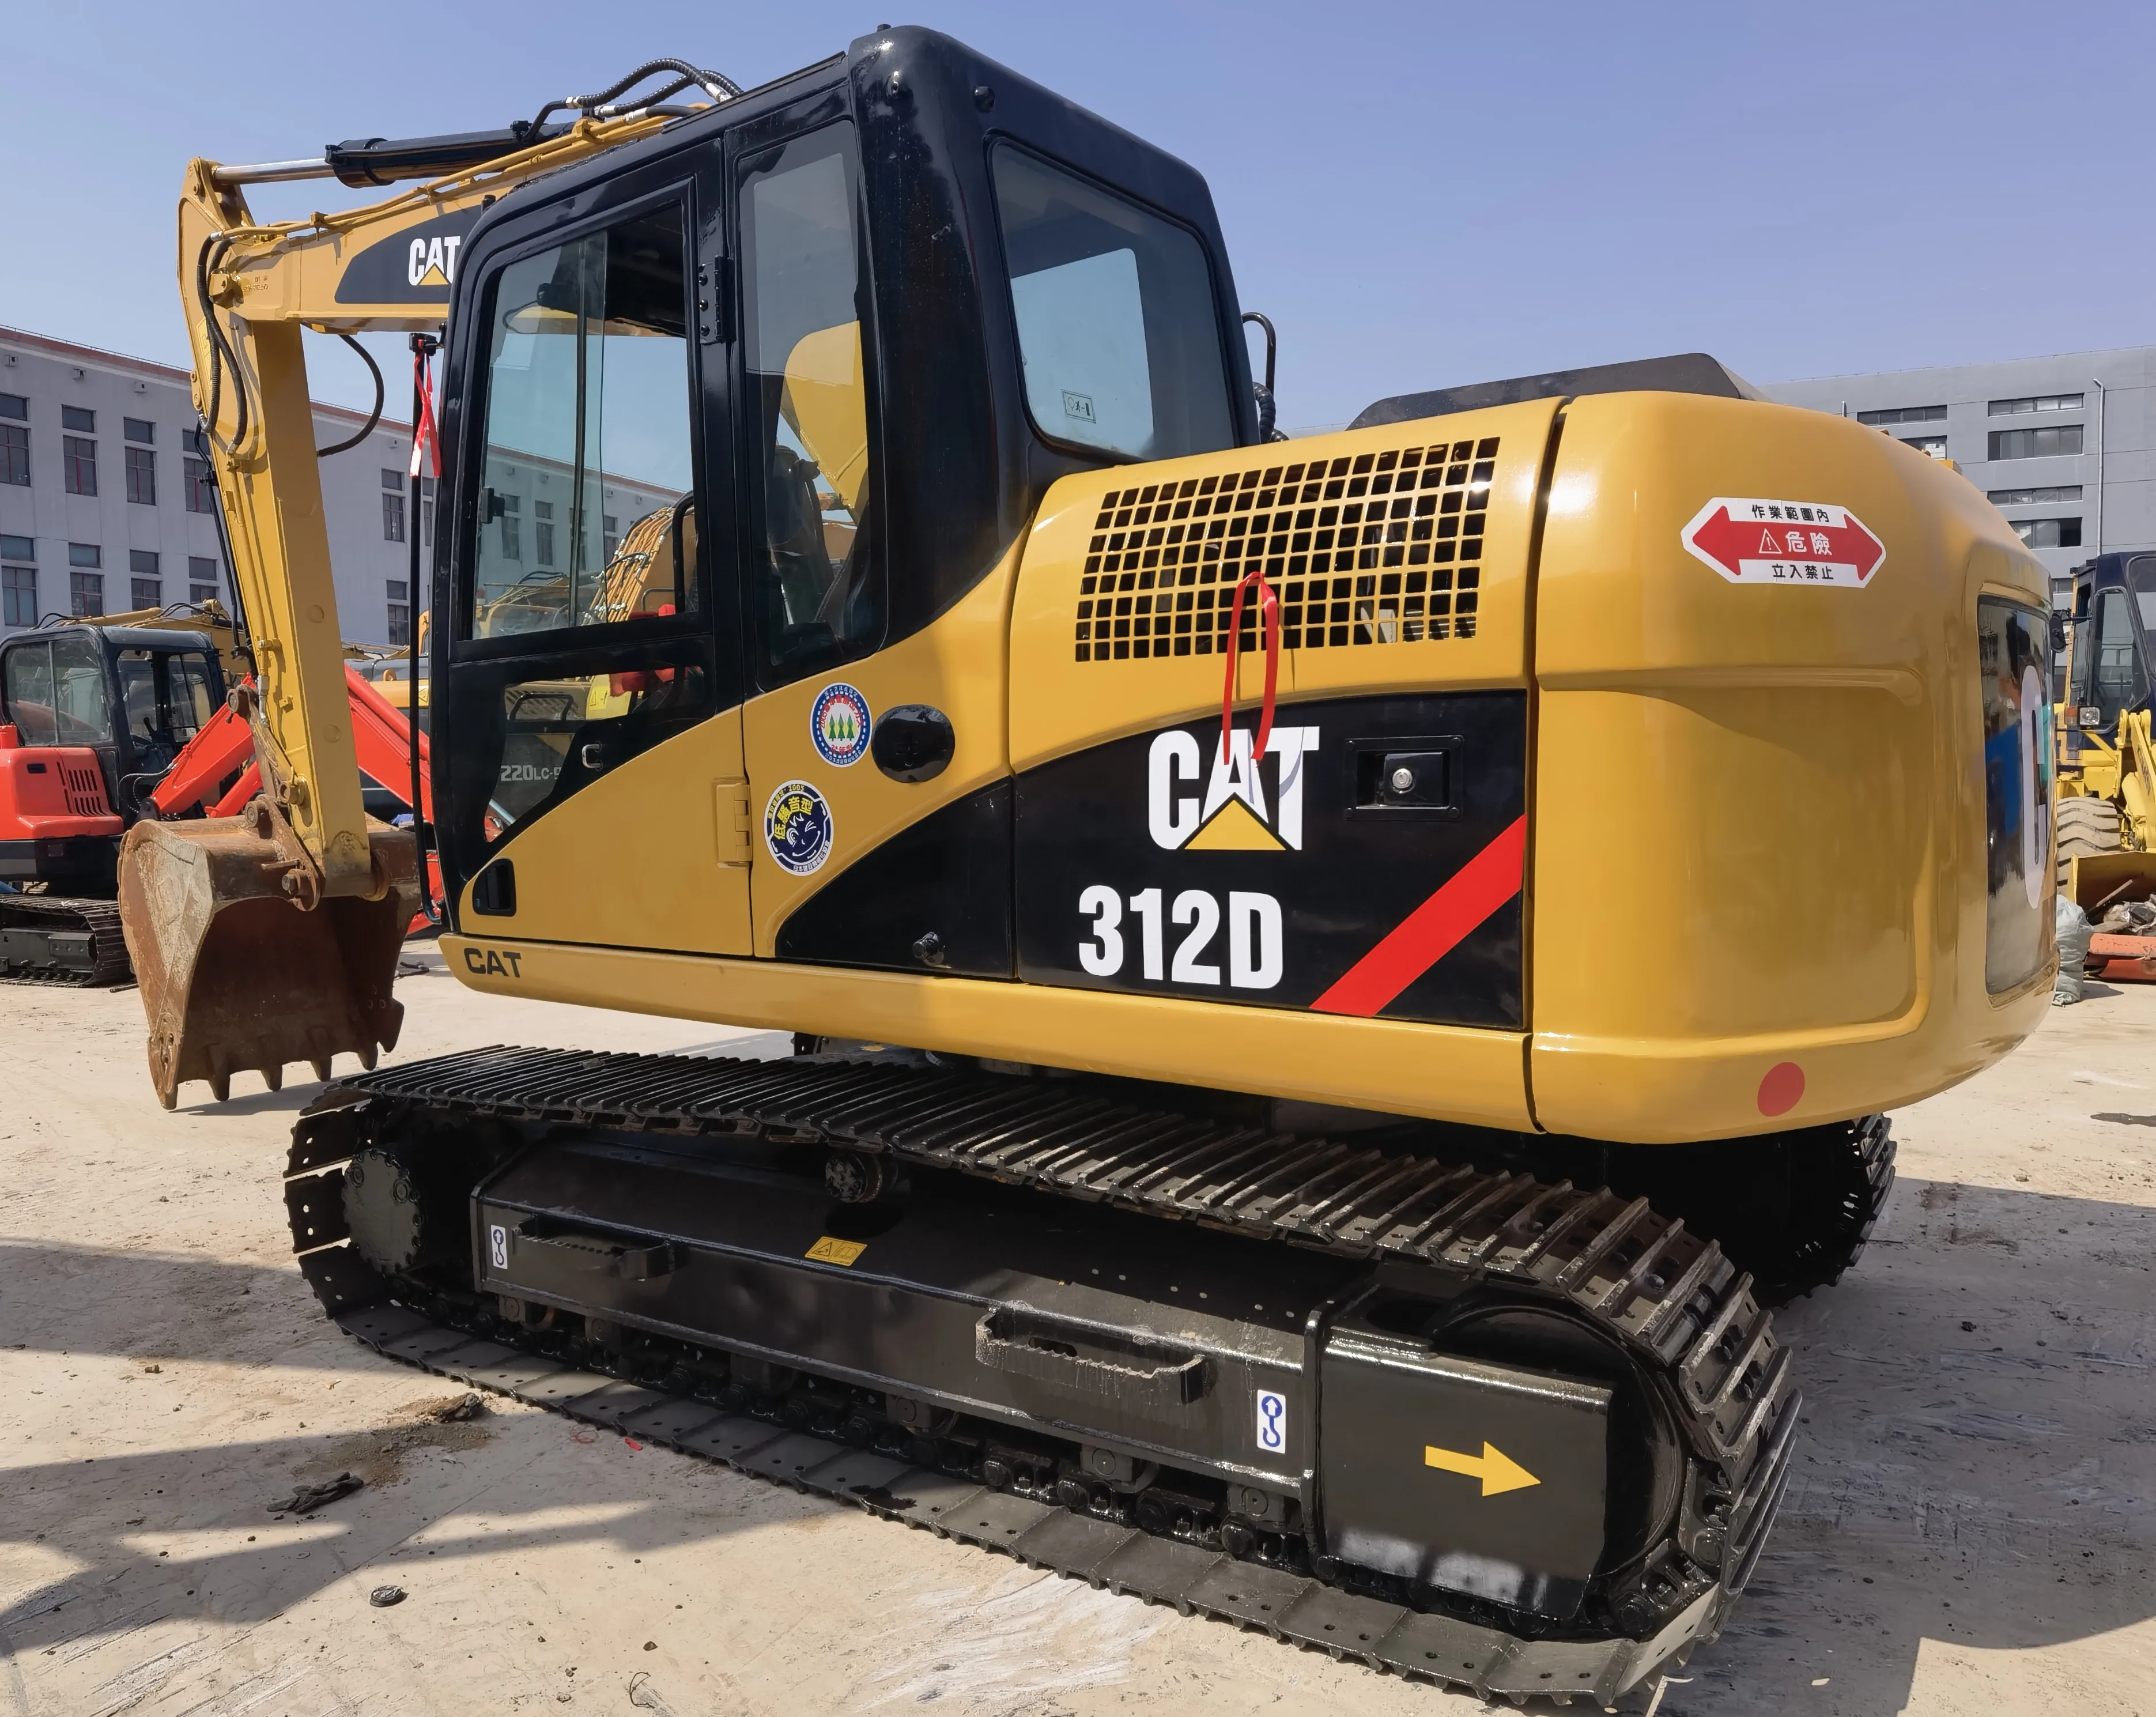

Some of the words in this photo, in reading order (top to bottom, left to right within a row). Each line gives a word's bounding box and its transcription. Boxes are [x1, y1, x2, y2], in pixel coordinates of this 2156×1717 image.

[408, 236, 460, 286] CAT
[1785, 531, 1832, 556] 危險
[1772, 564, 1834, 580] 立入禁止
[788, 784, 805, 792] 2005
[1149, 726, 1320, 851] CAT
[1078, 885, 1283, 990] 312D
[463, 948, 522, 978] CAT
